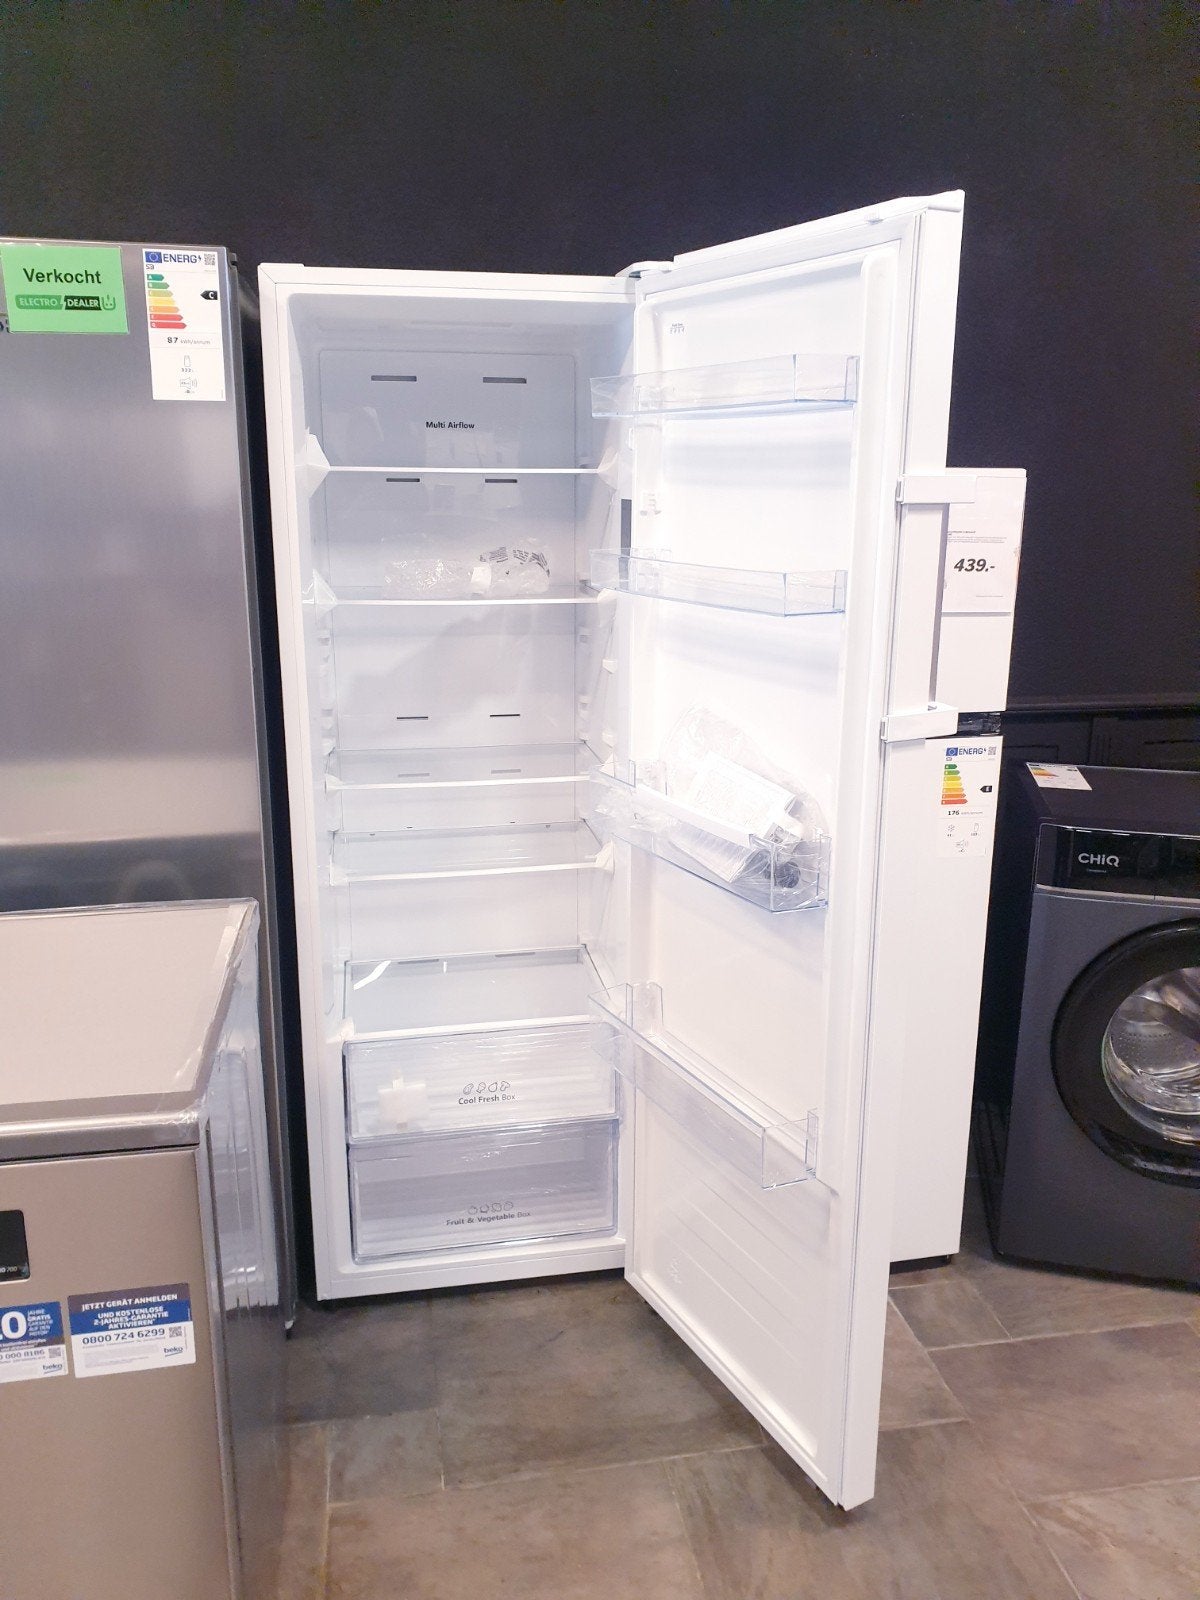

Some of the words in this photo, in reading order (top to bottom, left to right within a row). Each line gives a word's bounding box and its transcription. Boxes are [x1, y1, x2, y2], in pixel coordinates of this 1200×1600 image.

[163, 253, 198, 264] ENERG
[23, 268, 102, 284] Verkocht
[209, 291, 214, 299] C
[19, 298, 58, 307] ELECTRO
[66, 298, 99, 307] DEALER
[167, 336, 178, 344] 87
[426, 421, 446, 429] Multi
[447, 422, 475, 430] Airflow
[953, 558, 995, 572] 439.-
[959, 747, 983, 755] ENERG
[1078, 852, 1120, 868] CHiQ
[458, 1096, 476, 1105] Cool
[478, 1095, 500, 1104] Fresh
[501, 1093, 516, 1101] Box
[477, 1213, 515, 1224] Vegetable
[517, 1211, 531, 1219] Box
[82, 1302, 105, 1312] JETZT
[134, 1293, 178, 1305] ANMELDEN
[115, 1306, 164, 1317] KOSTENLOSE
[0, 1310, 27, 1340] 0
[82, 1334, 112, 1345] 0800
[113, 1331, 135, 1341] 724
[137, 1328, 166, 1338] 6299
[163, 1346, 184, 1354] beko
